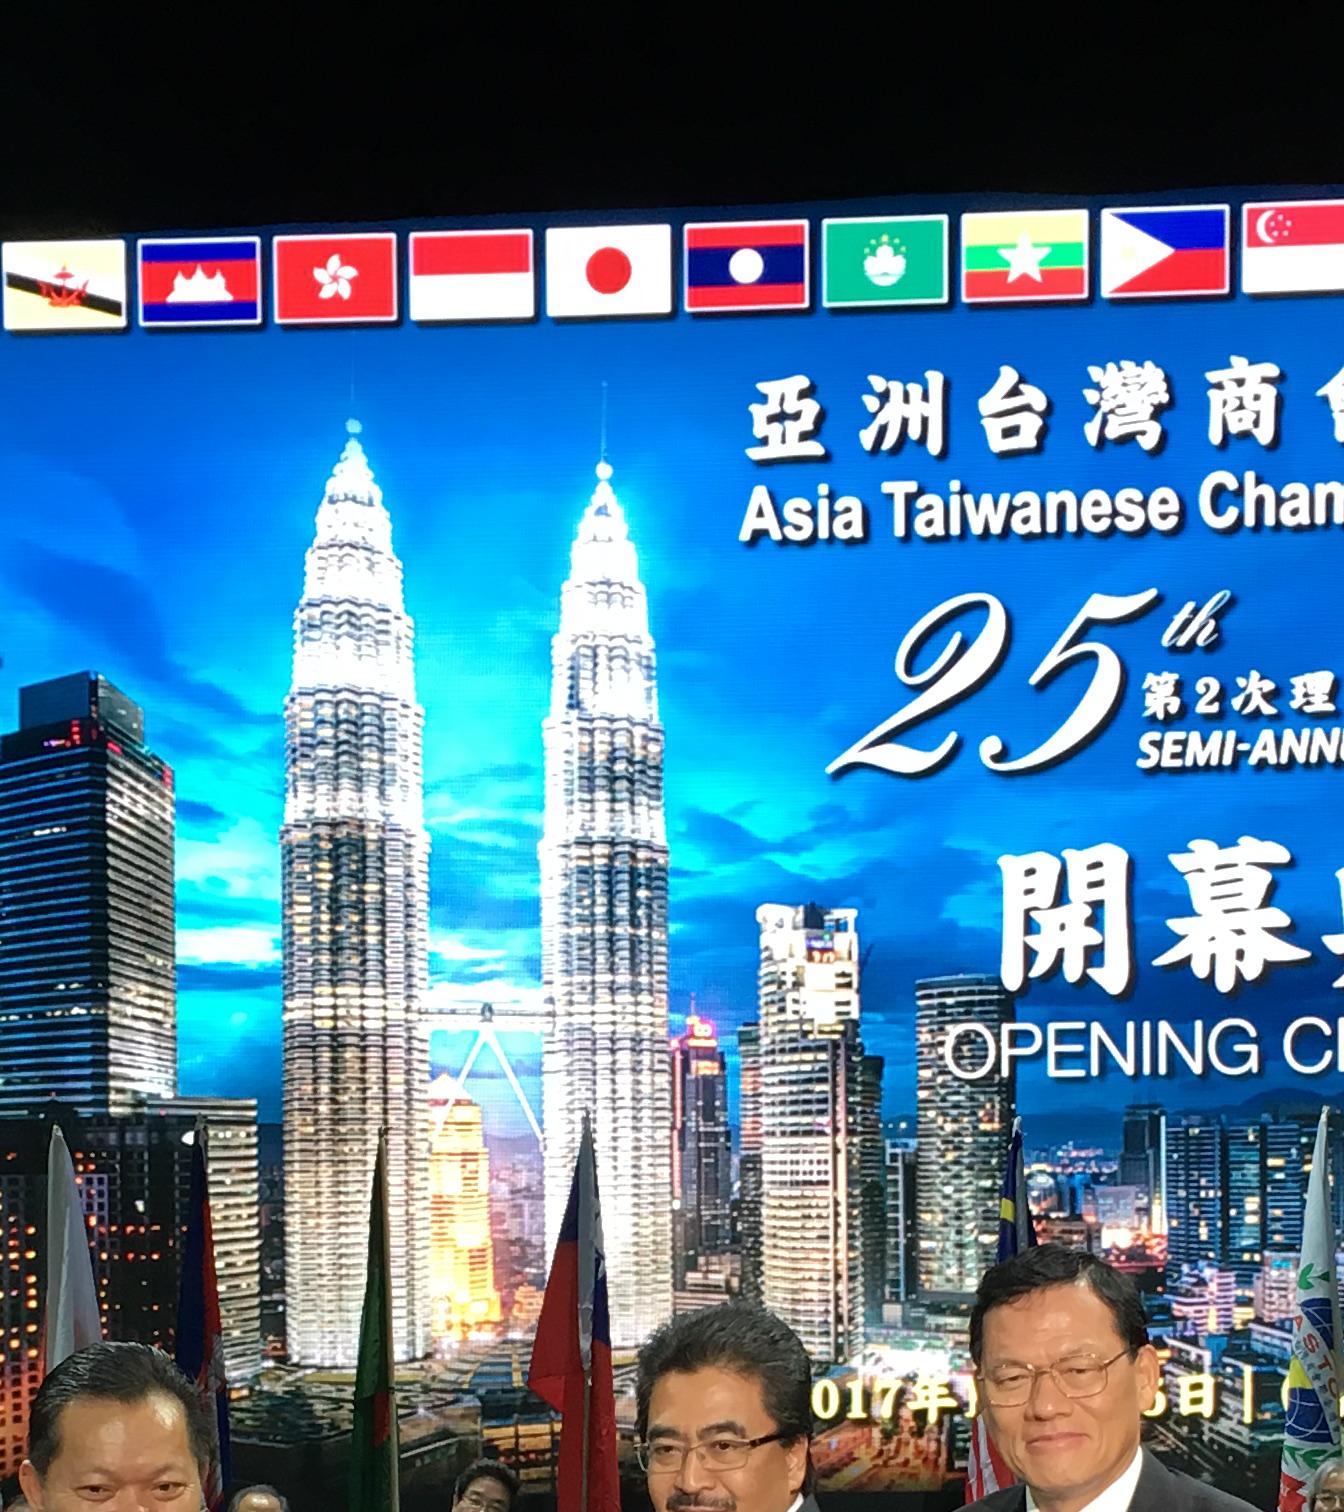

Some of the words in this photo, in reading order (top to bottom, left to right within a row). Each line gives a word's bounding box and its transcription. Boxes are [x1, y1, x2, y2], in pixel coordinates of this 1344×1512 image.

[739, 483, 864, 541] Asia
[882, 480, 1180, 539] Taiwanese
[944, 1016, 1261, 1081] OPENING
